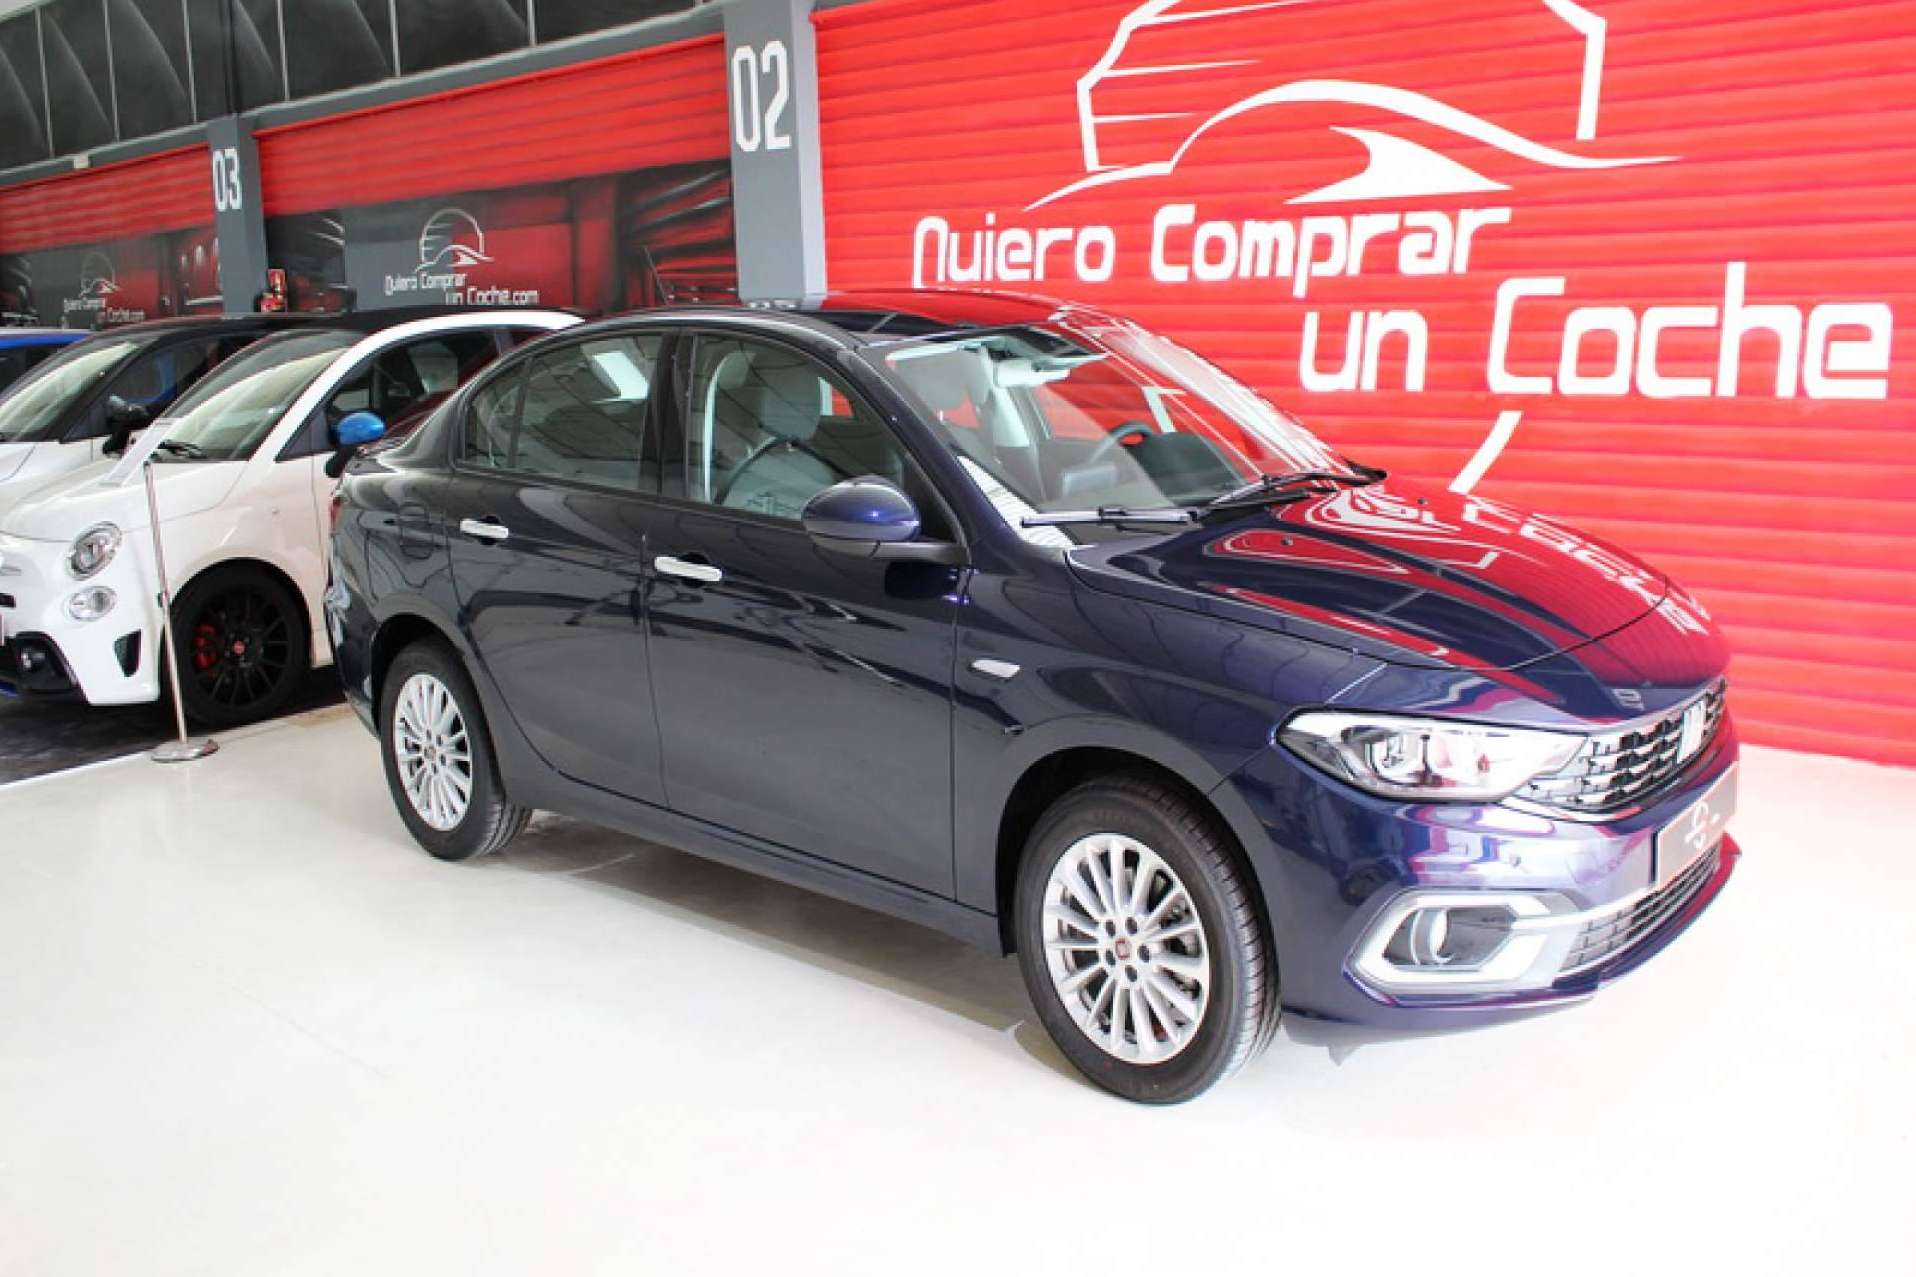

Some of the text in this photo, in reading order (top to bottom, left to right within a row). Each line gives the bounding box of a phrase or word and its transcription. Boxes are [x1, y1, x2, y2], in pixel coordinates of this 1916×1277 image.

[733, 40, 791, 152] 02
[213, 148, 242, 210] 03
[912, 203, 1512, 299] Quiero Comprar
[1300, 261, 1894, 399] un Coche
